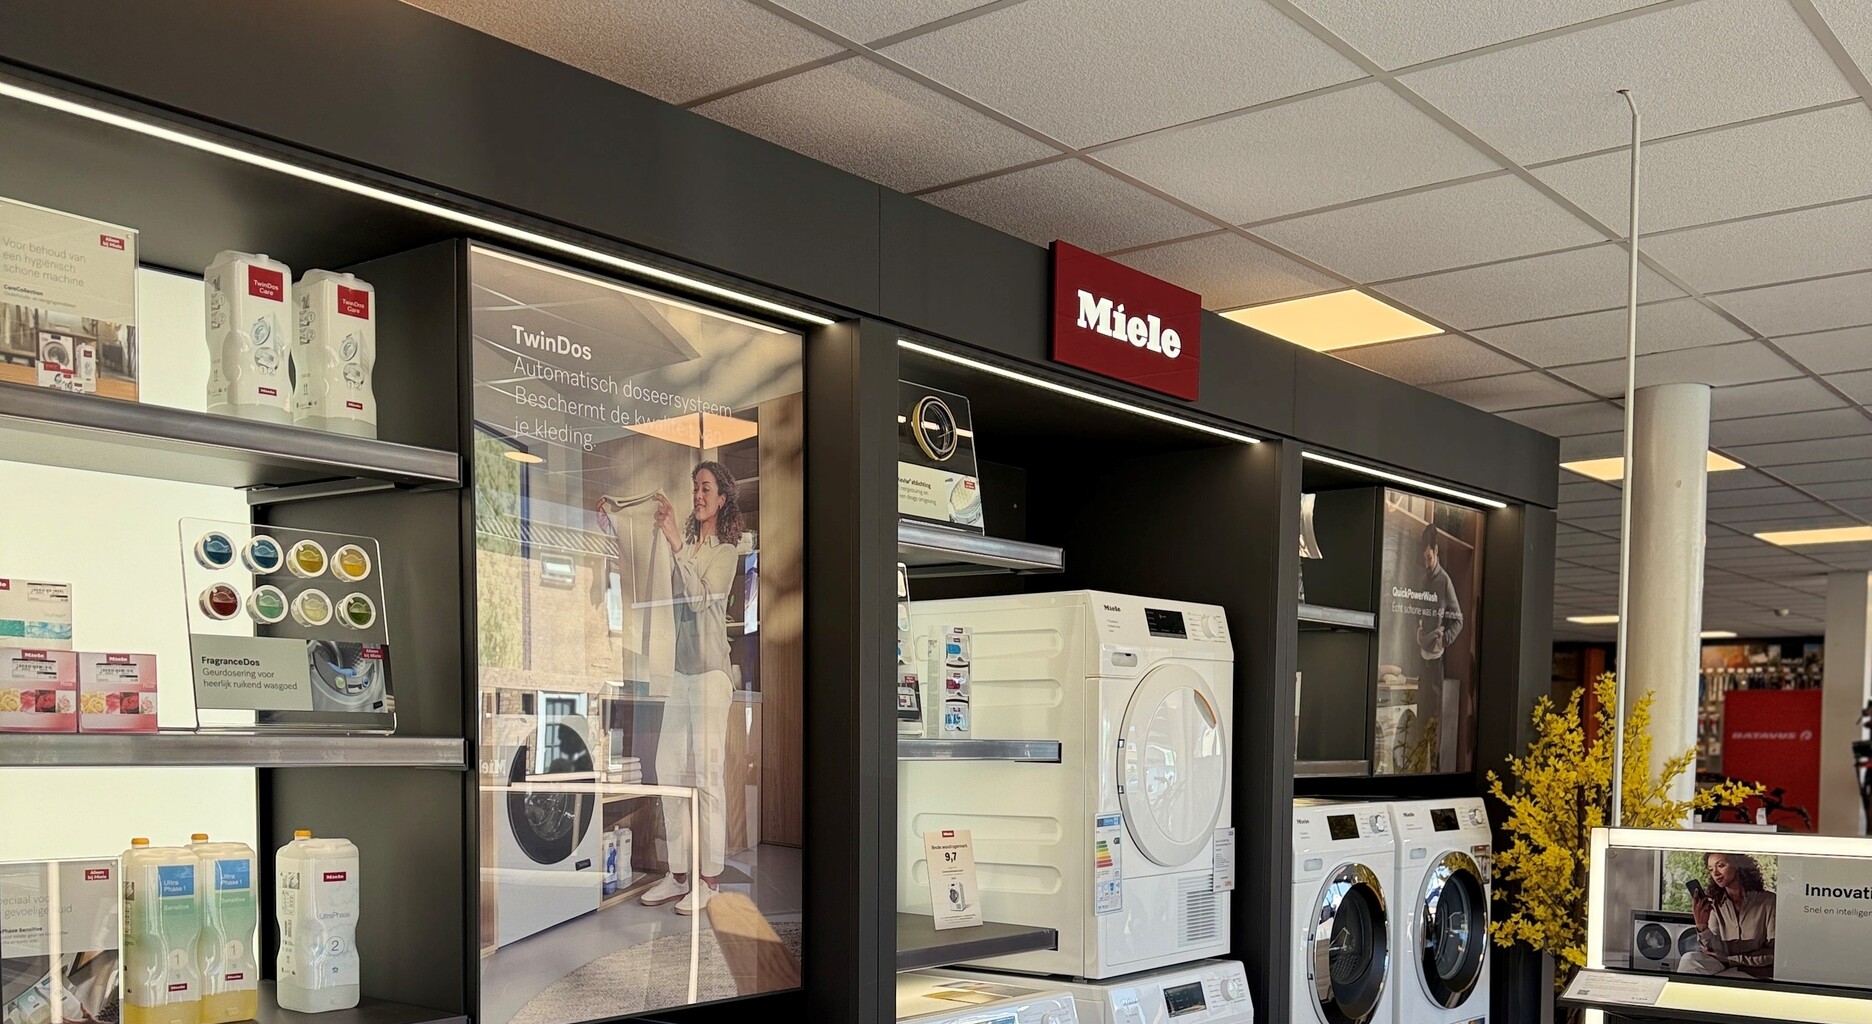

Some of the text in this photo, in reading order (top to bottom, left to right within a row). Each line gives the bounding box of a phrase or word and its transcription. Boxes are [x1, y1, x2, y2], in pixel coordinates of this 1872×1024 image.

[2, 237, 86, 263] Voor behoud van
[2, 251, 21, 262] een
[3, 263, 84, 287] schone machine
[4, 284, 44, 296] CareCollection
[254, 279, 279, 291] TwinDos
[259, 287, 274, 296] Care
[342, 298, 365, 309] TwinDos
[347, 306, 360, 314] Care
[1077, 289, 1181, 358] Miele
[511, 324, 592, 360] TwinDos
[513, 356, 732, 418] Automatisch doseersysteem
[515, 386, 605, 421] Beschermt
[610, 407, 630, 425] de
[515, 416, 597, 452] je kleding.
[1392, 586, 1438, 602] QuickPowerWash
[1103, 604, 1121, 612] Miele
[1404, 604, 1421, 615] schone
[1422, 608, 1432, 616] was
[201, 656, 261, 667] FragranceDos
[202, 668, 257, 679] Geurdosering
[203, 680, 298, 691] heerlijk ruikend wasgoed
[944, 852, 957, 863] 9,7
[2, 895, 31, 905] eciaal
[4, 907, 50, 919] gevoelige
[1804, 905, 1822, 914] Snel
[320, 912, 351, 920] UltraPhase
[331, 940, 340, 951] 2
[174, 955, 180, 965] 1
